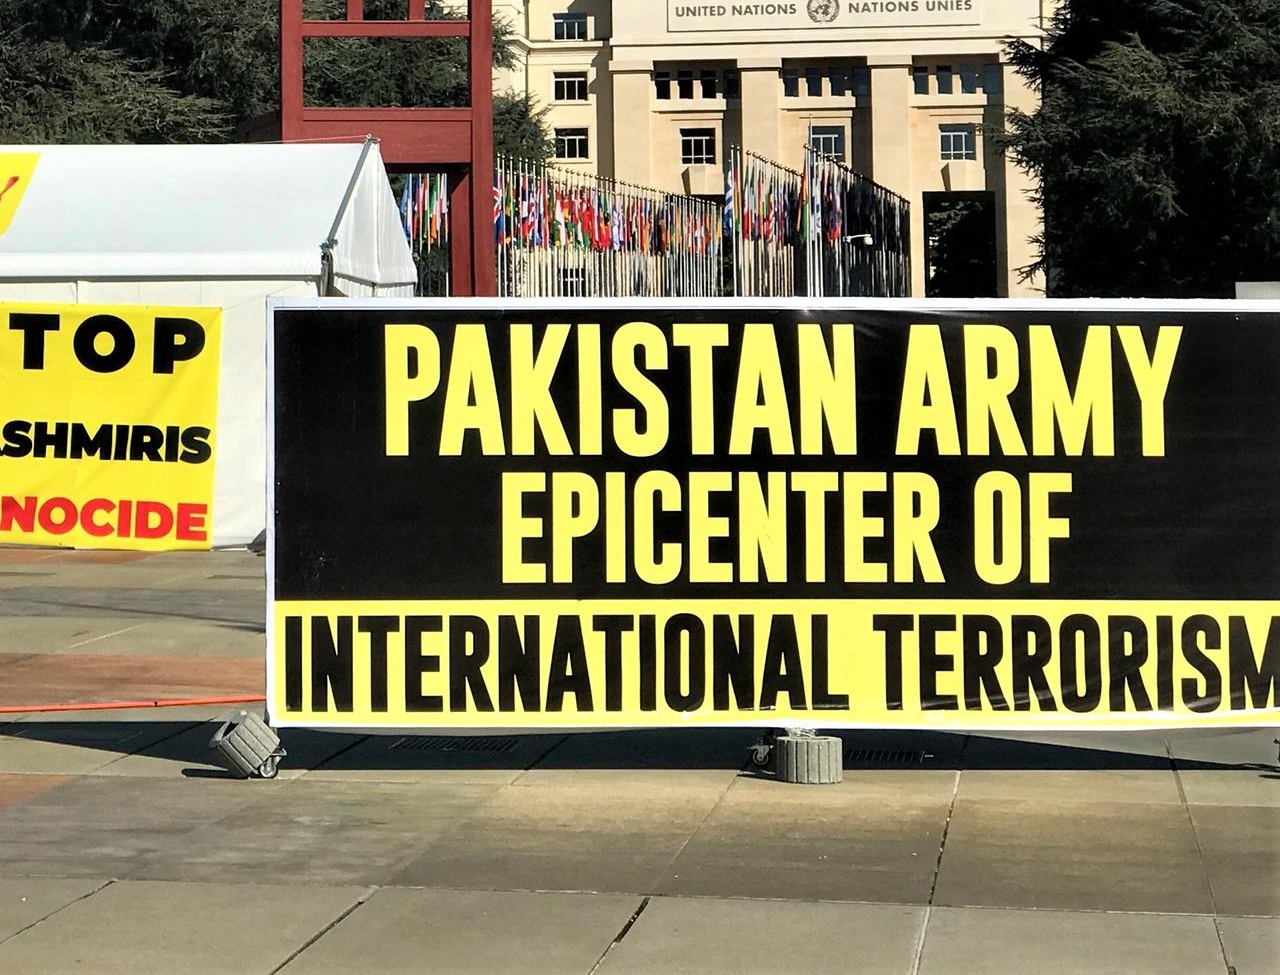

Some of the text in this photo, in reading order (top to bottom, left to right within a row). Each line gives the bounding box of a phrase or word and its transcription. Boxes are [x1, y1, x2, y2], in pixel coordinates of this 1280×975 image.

[675, 3, 797, 18] UNITED NATIONS
[848, 0, 972, 13] NATIONS UNIES
[384, 321, 1184, 458] PAKISTAN ARMY
[501, 470, 1073, 585] EPICENTER OF
[285, 612, 1280, 714] INTERNATIONAL TERRORISM
